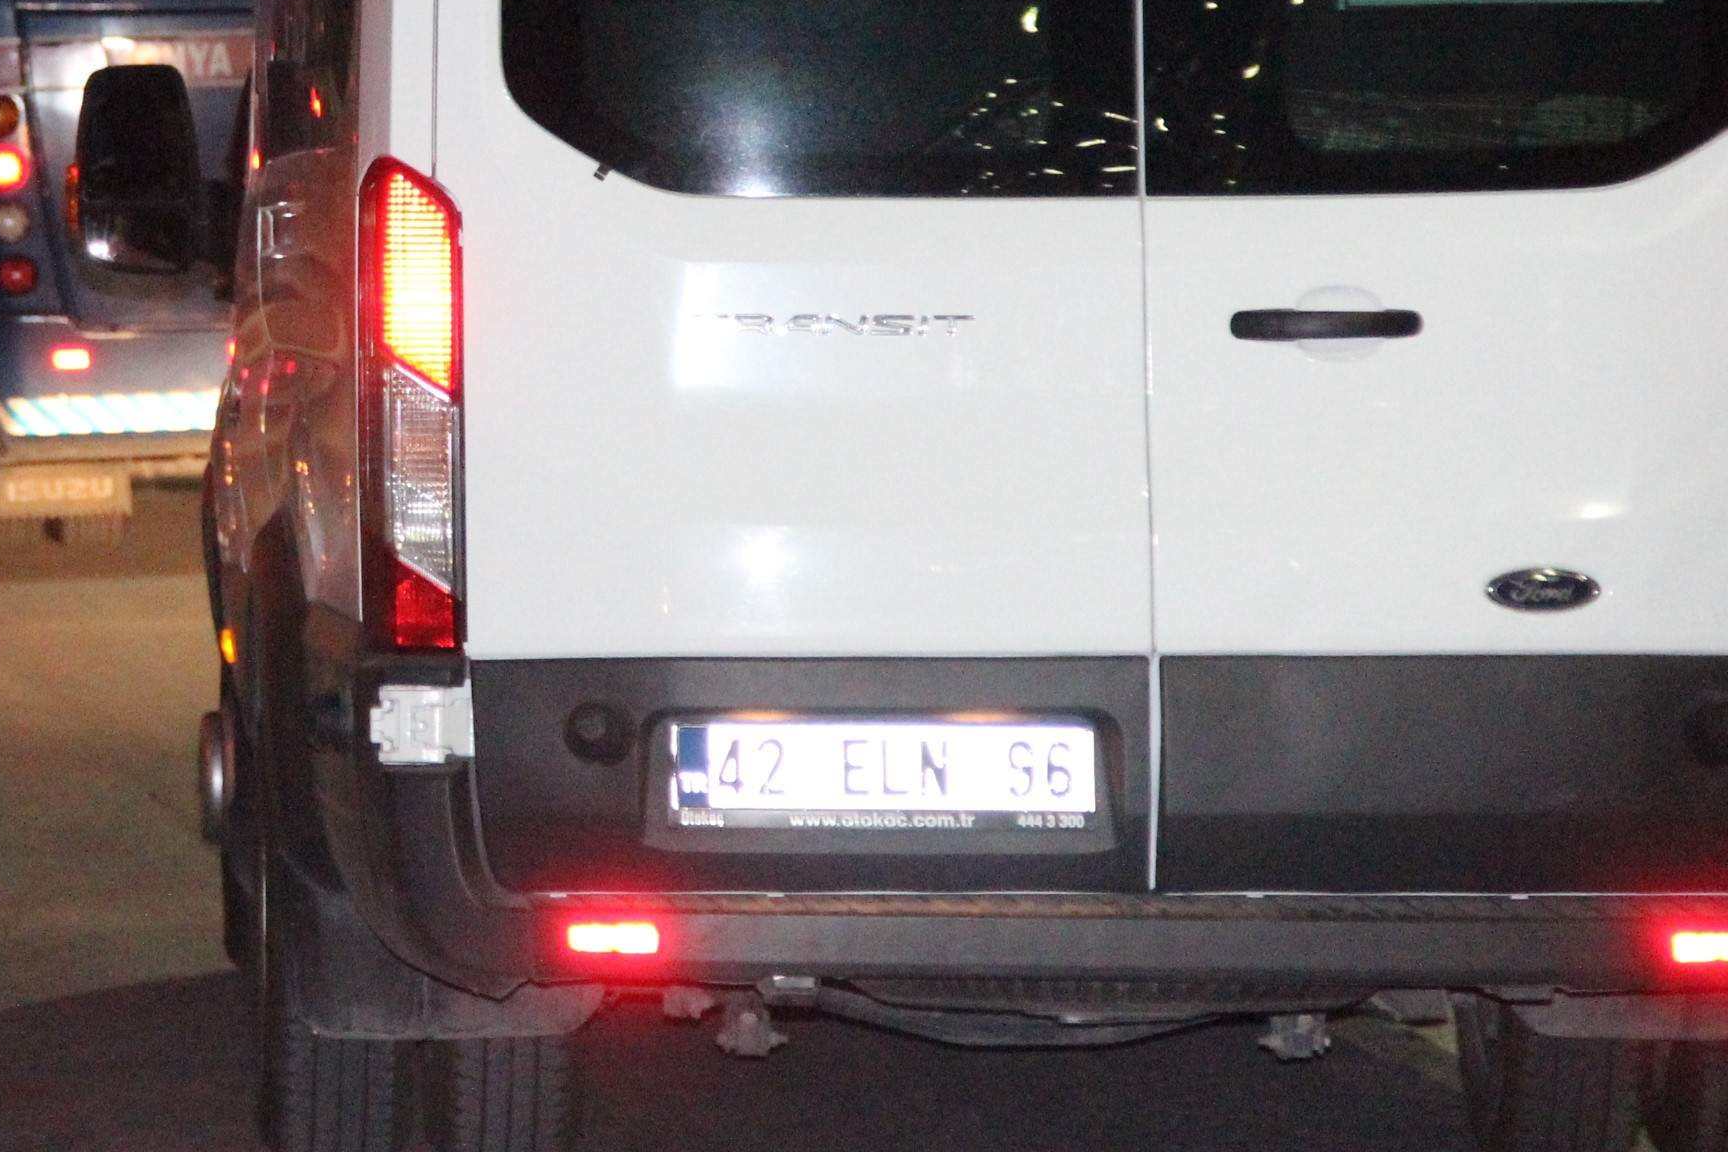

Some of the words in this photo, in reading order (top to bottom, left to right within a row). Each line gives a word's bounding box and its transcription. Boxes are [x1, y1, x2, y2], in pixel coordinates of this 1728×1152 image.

[719, 739, 785, 794] 42
[843, 740, 947, 796] ELN
[1046, 814, 1056, 828] 3
